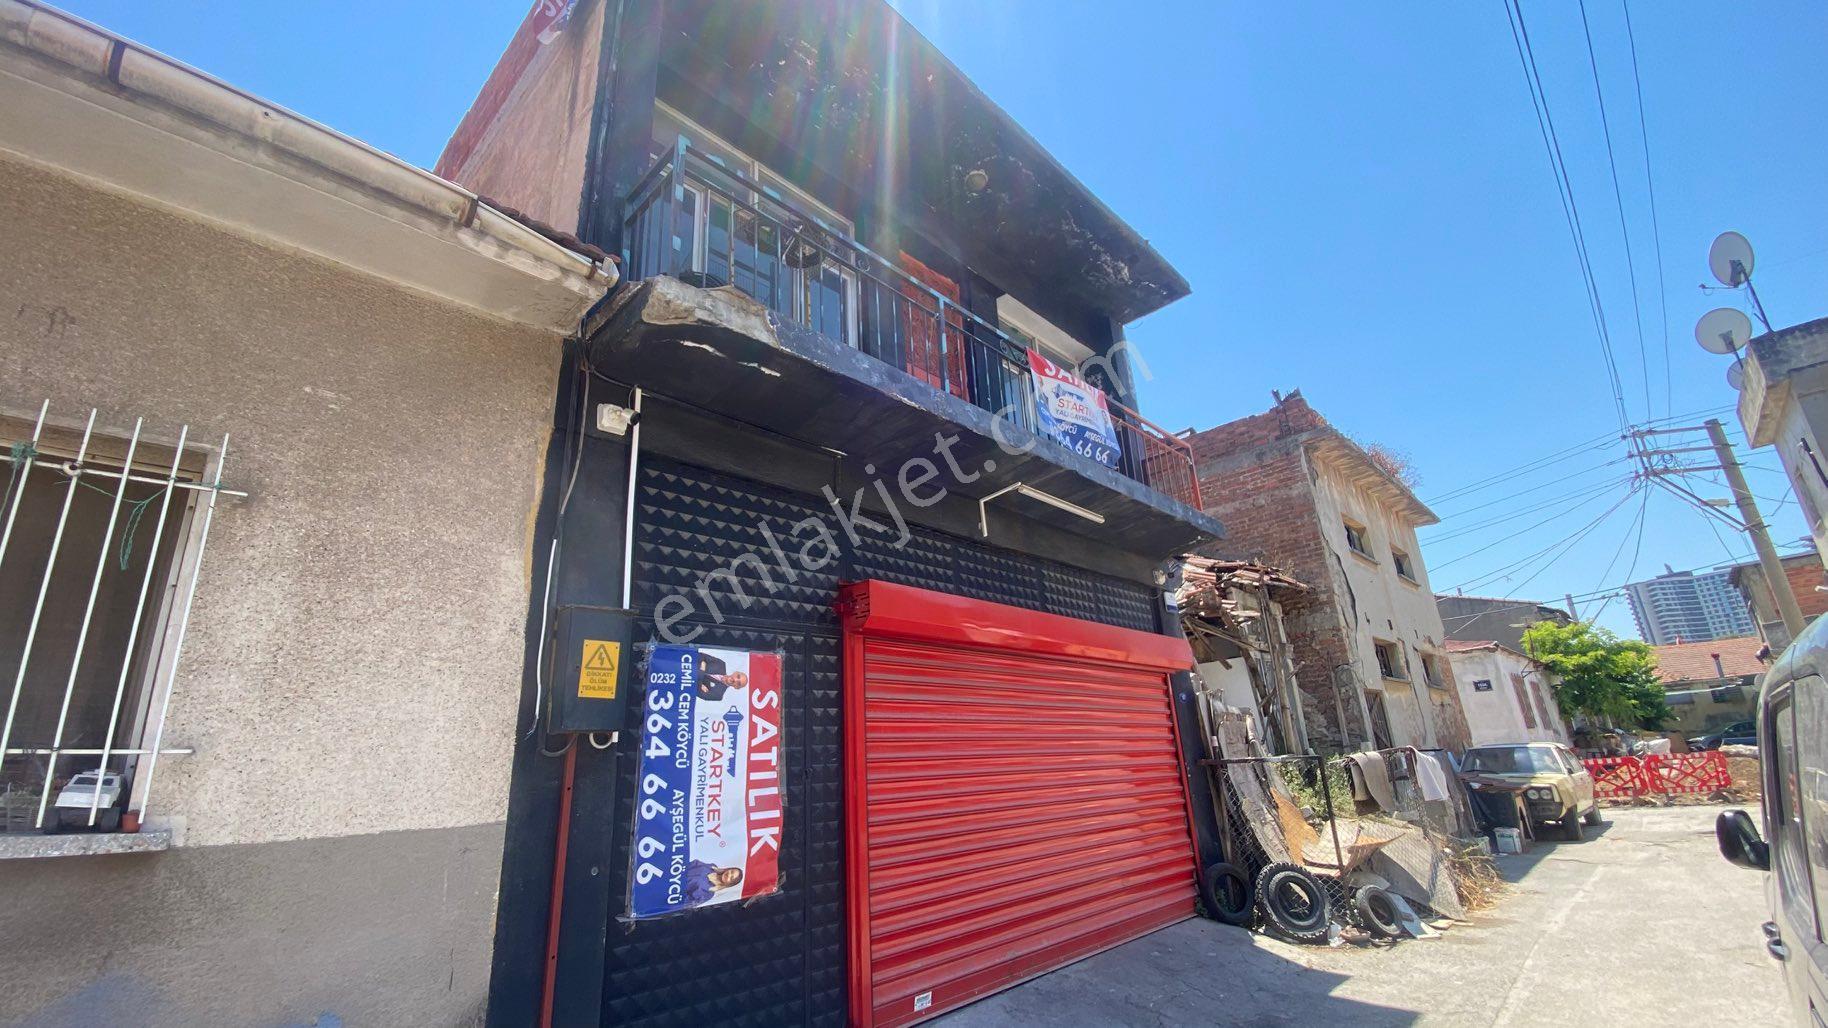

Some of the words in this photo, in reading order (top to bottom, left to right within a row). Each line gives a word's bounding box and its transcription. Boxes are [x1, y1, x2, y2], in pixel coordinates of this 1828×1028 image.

[1075, 441, 1092, 458] 66
[1095, 447, 1110, 463] 66
[650, 673, 676, 684] 0232
[680, 654, 693, 690] CEMİL
[644, 690, 674, 759] 364
[677, 693, 690, 720] CEM
[675, 722, 692, 768] KÖYCÜ
[699, 717, 709, 746] YALI
[641, 773, 668, 820] 66
[694, 748, 708, 842] GAYRİMENKUL
[707, 720, 726, 839] STARTKEY
[748, 689, 780, 857] SATILIK
[669, 789, 687, 852] AYŞEGÜL
[636, 836, 666, 884] 66
[667, 855, 684, 904] KÖYCÜ
